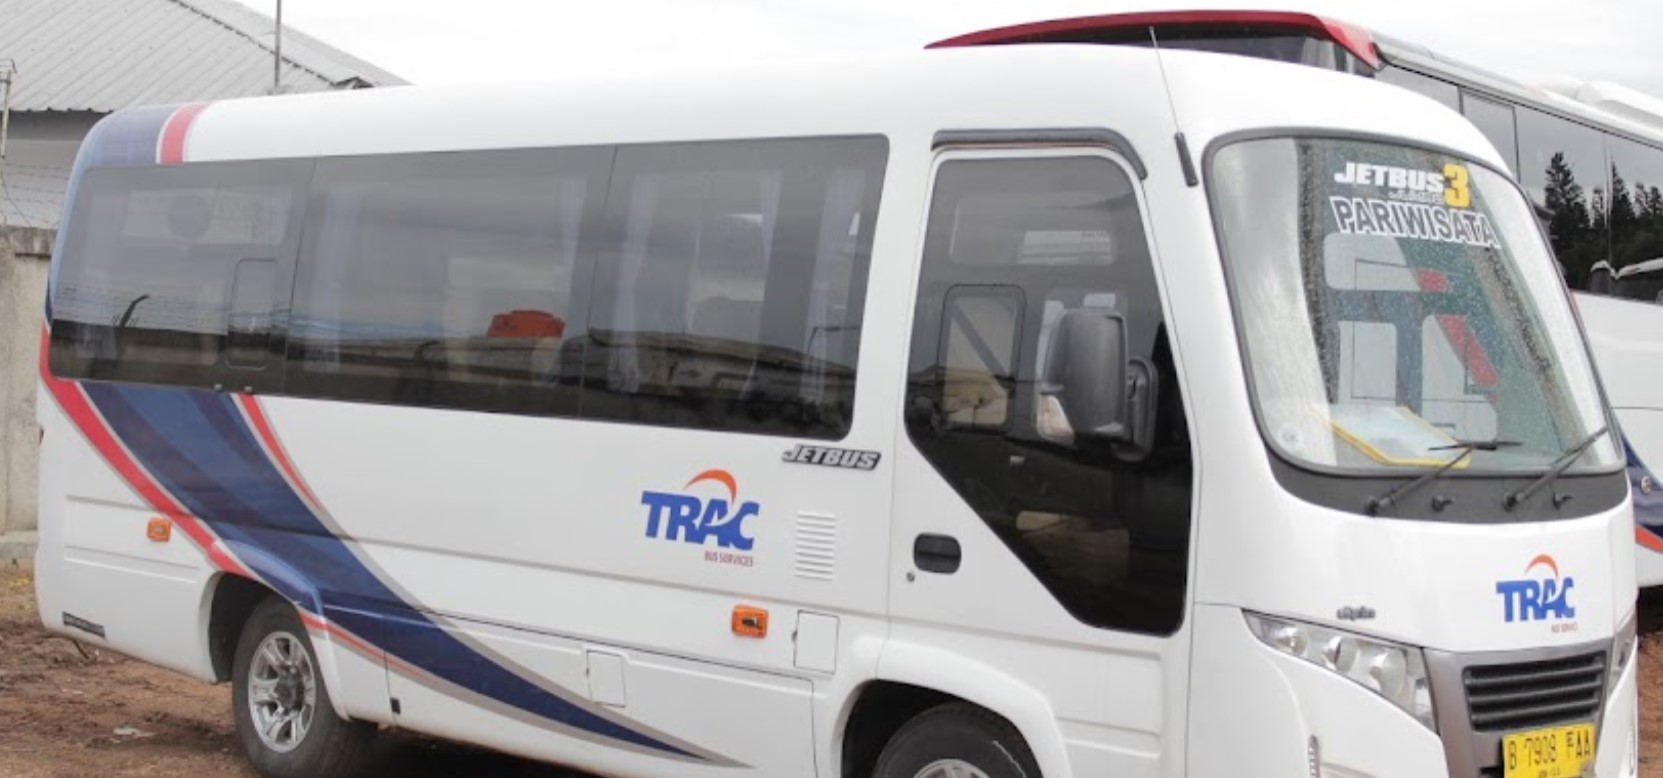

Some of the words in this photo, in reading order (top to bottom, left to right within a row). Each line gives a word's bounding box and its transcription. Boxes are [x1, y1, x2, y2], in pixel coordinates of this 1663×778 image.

[1330, 196, 1500, 249] PARIWISATA
[782, 444, 880, 471] JETBUS
[641, 491, 759, 551] TRAC
[1496, 577, 1575, 622] TRAC
